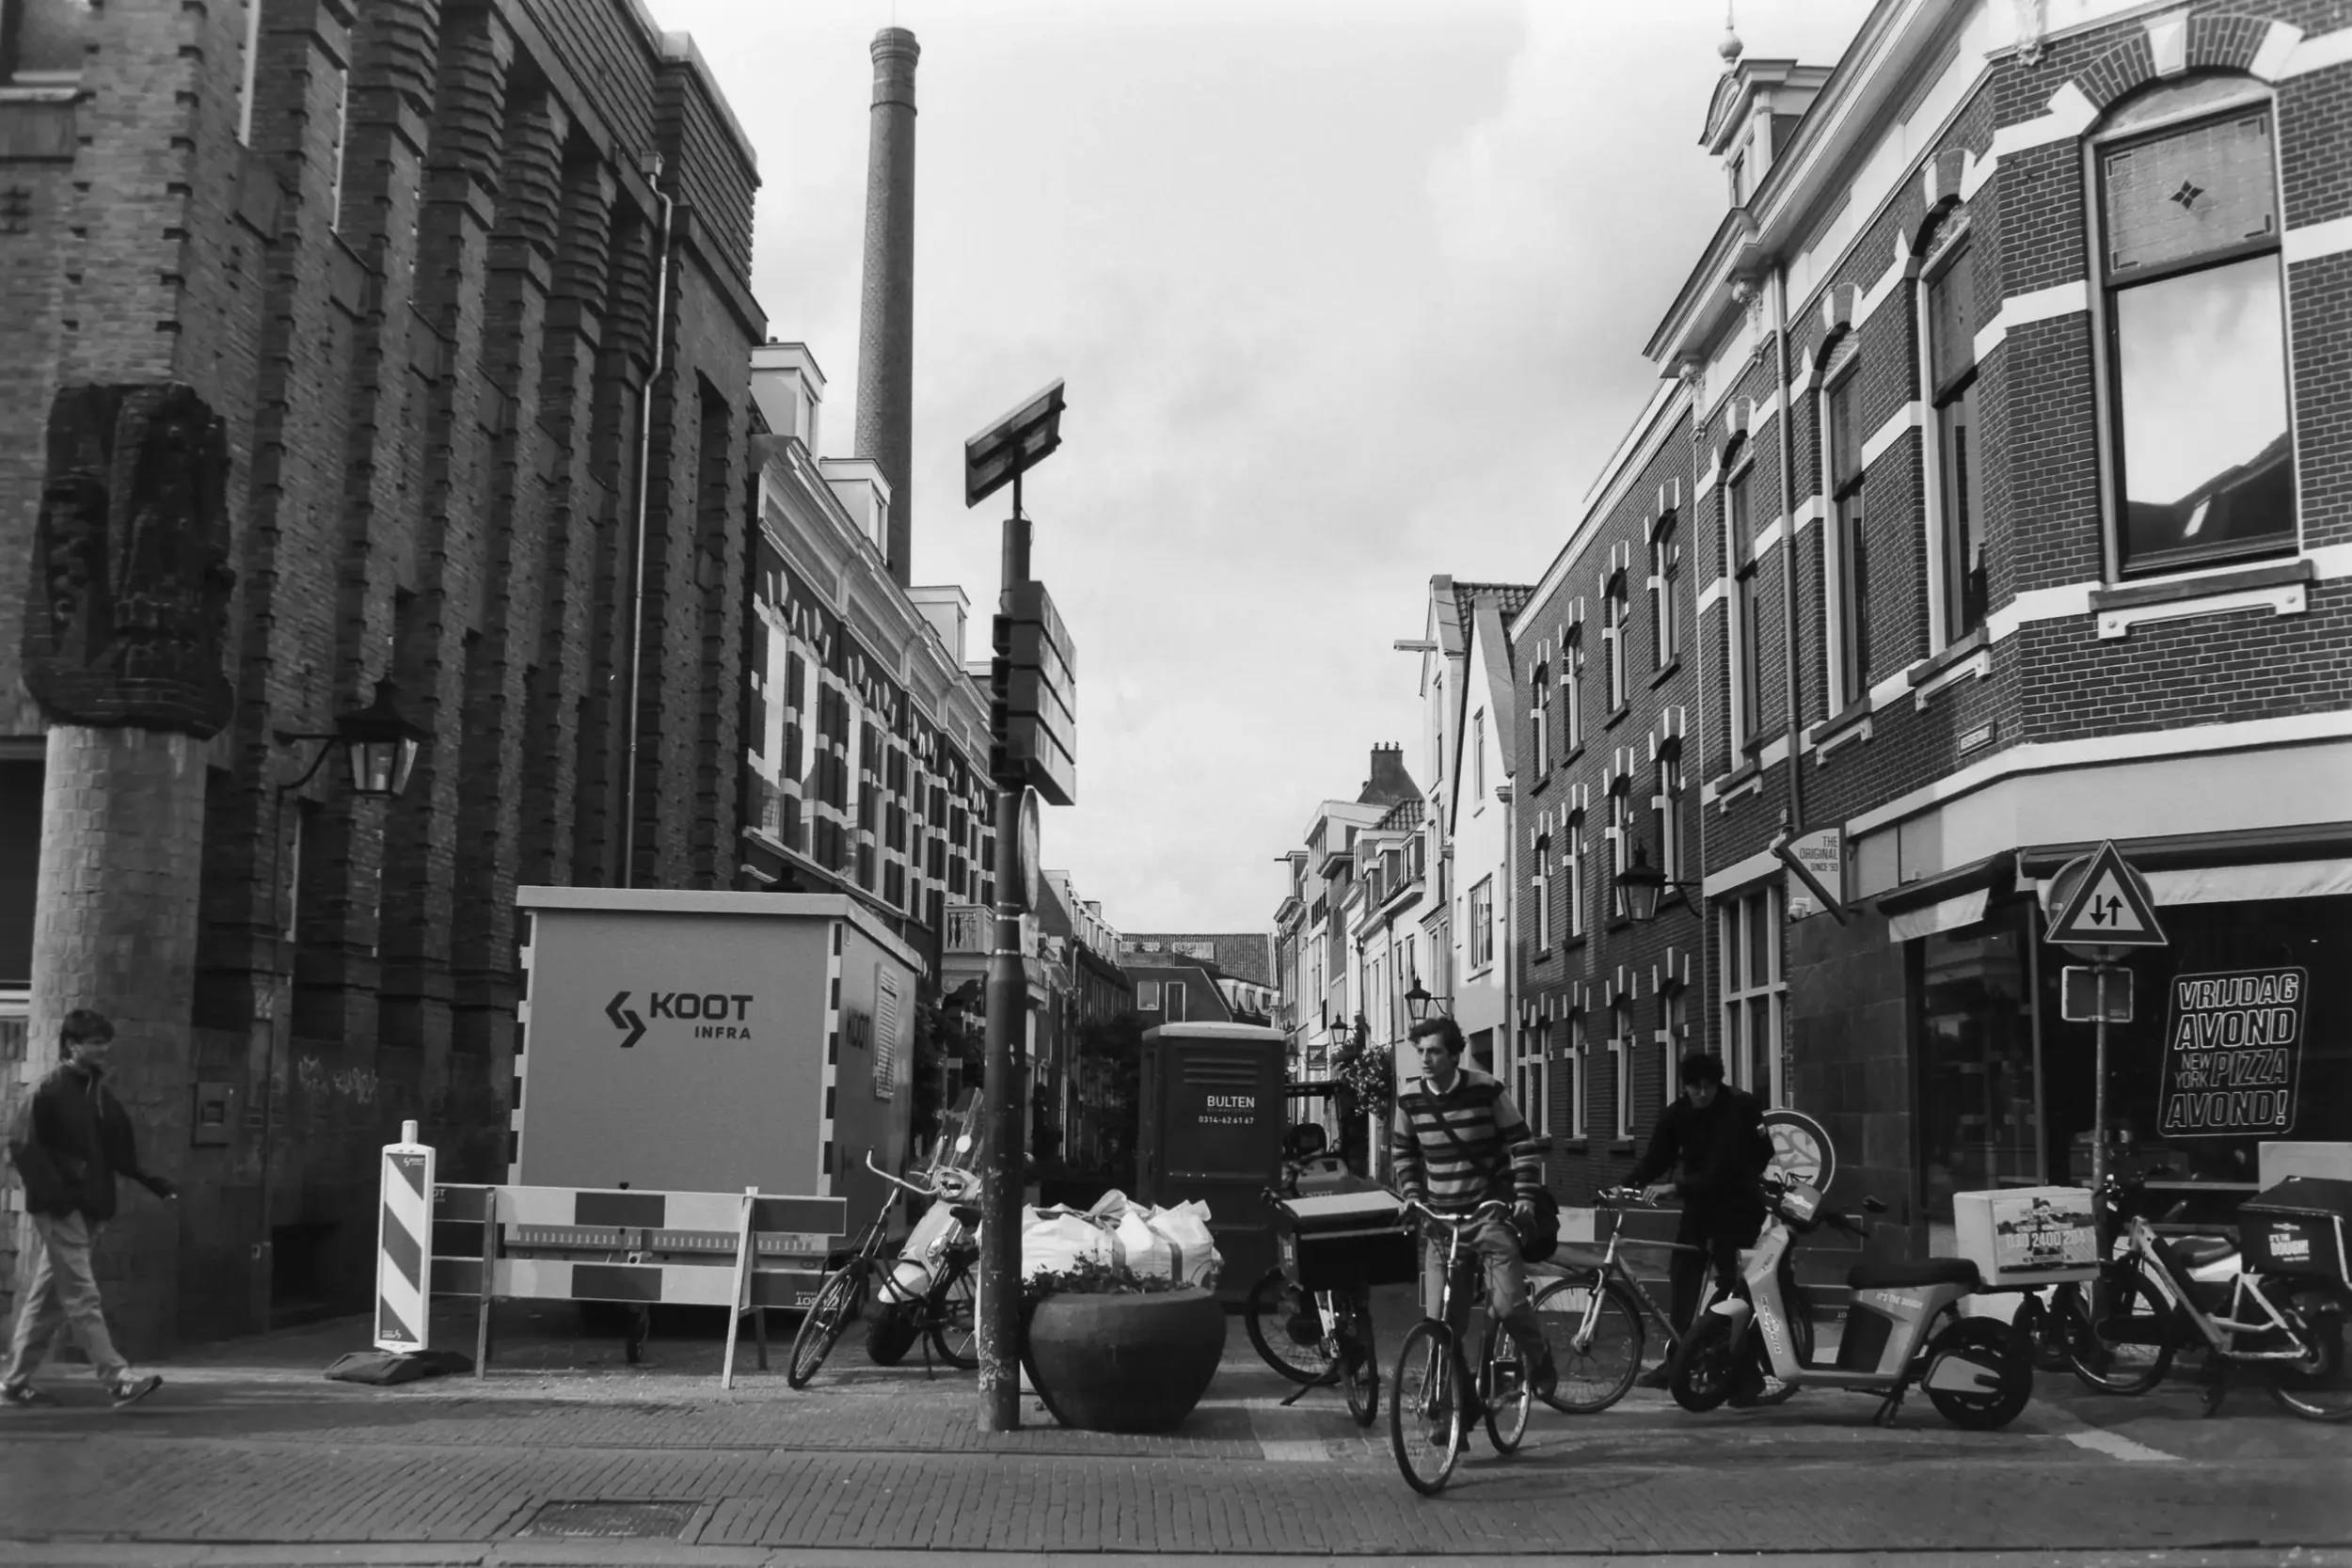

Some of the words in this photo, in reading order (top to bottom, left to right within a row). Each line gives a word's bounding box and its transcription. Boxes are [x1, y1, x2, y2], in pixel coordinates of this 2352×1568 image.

[1822, 835, 1838, 847] THE
[1799, 847, 1838, 860] ORIGINAL
[2179, 974, 2298, 1009] VRIJDAG
[649, 991, 754, 1022] KOOT
[694, 1025, 752, 1039] INFRA
[2174, 1007, 2296, 1050] AVOND
[2182, 1053, 2212, 1069] NEW
[2210, 1048, 2288, 1086] PIZZA
[2175, 1071, 2209, 1088] YORK
[1207, 1095, 1255, 1108] BULTEN
[2165, 1089, 2288, 1128] AVOND!
